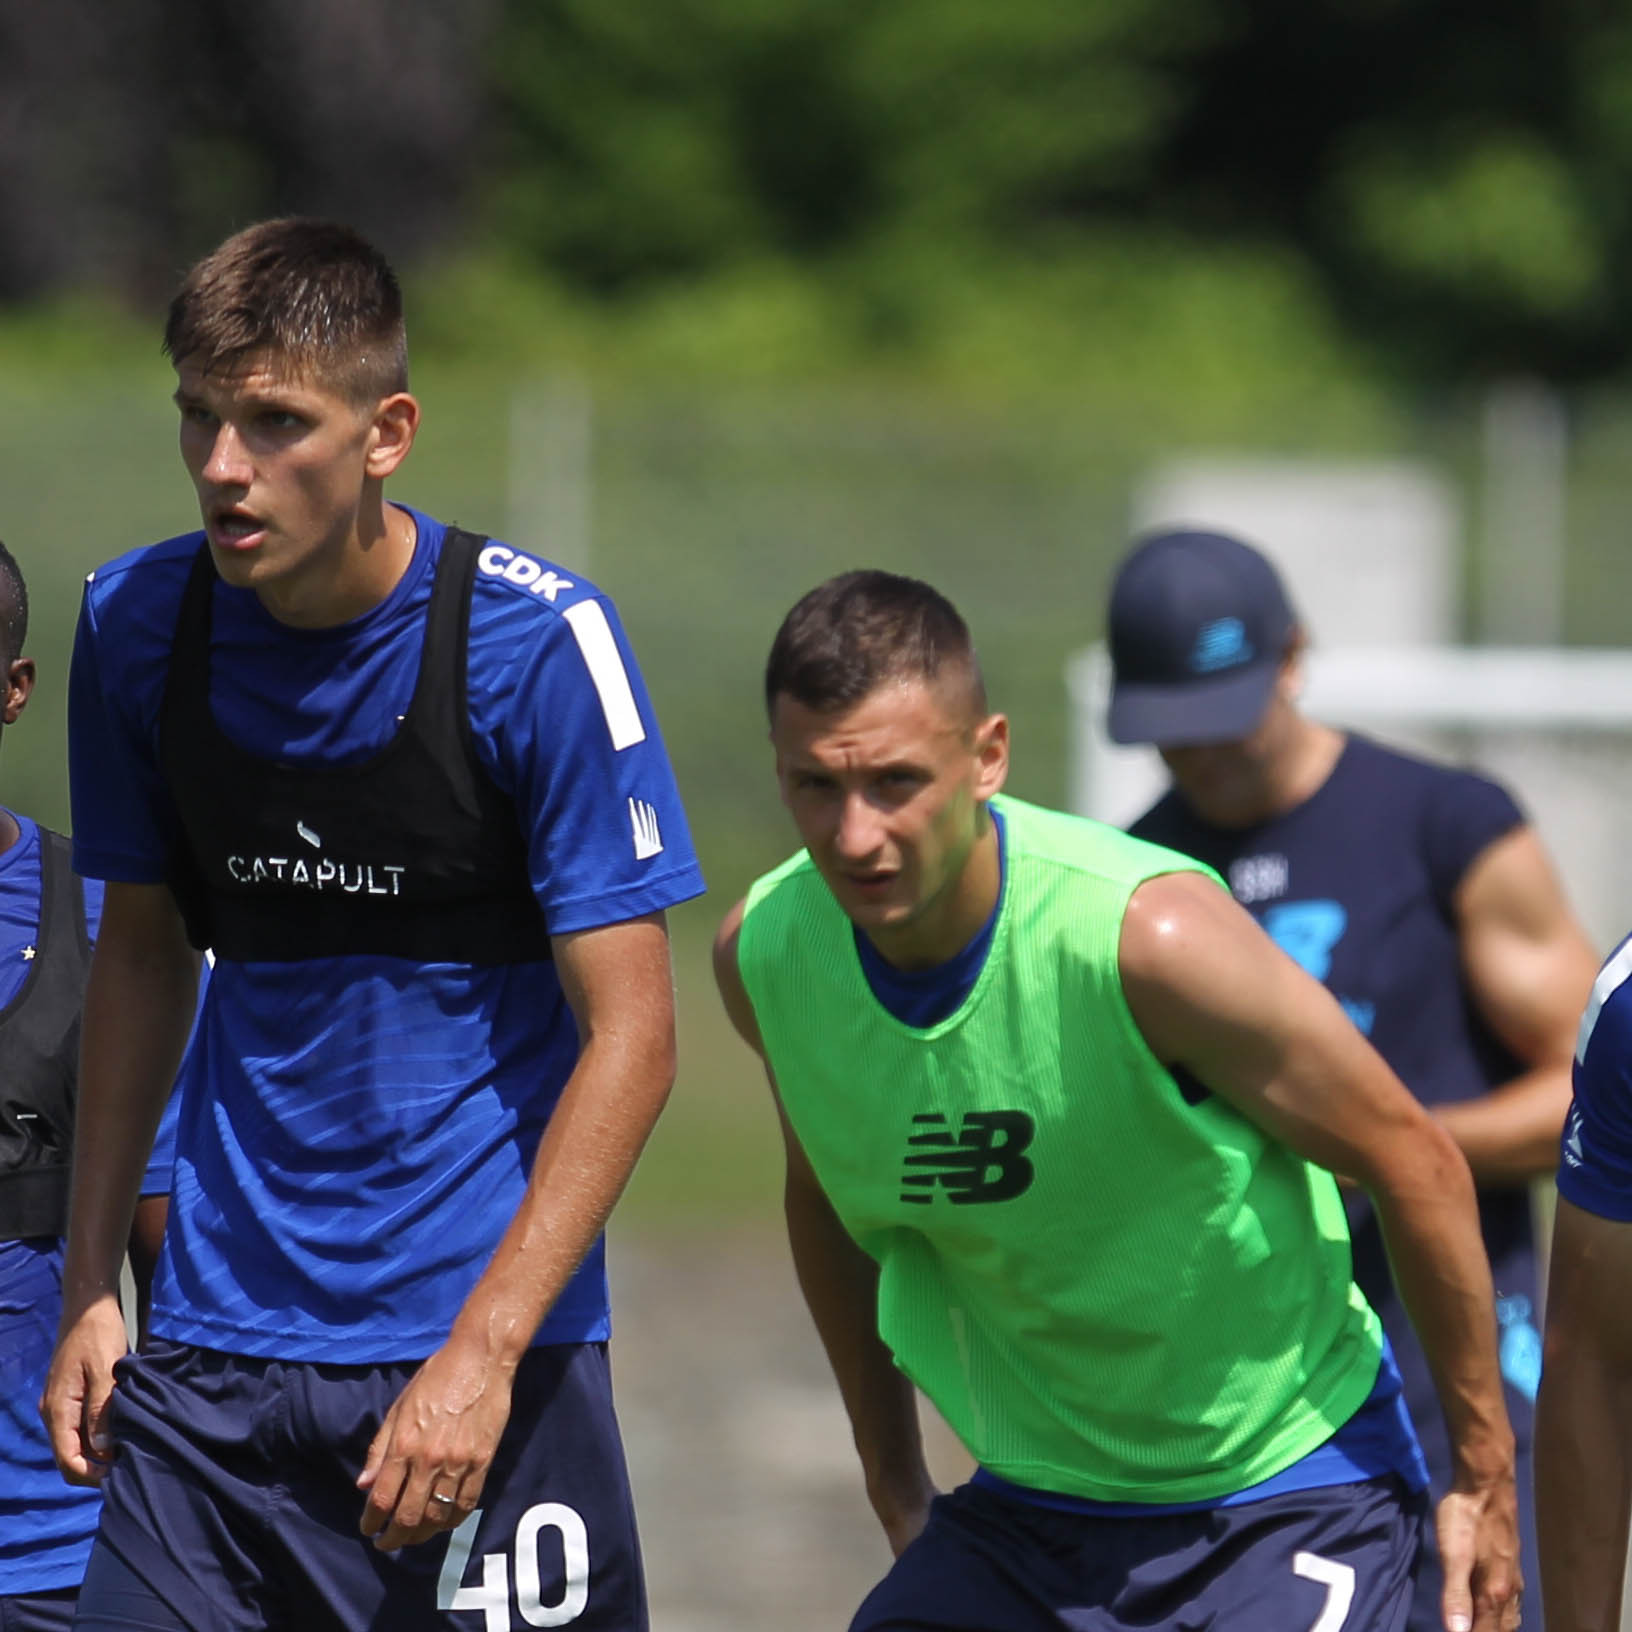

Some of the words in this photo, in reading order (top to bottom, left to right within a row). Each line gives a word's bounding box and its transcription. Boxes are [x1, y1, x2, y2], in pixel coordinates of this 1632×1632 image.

[477, 545, 574, 602] CDK
[228, 856, 404, 895] CATAPULT
[900, 1109, 1035, 1204] NB
